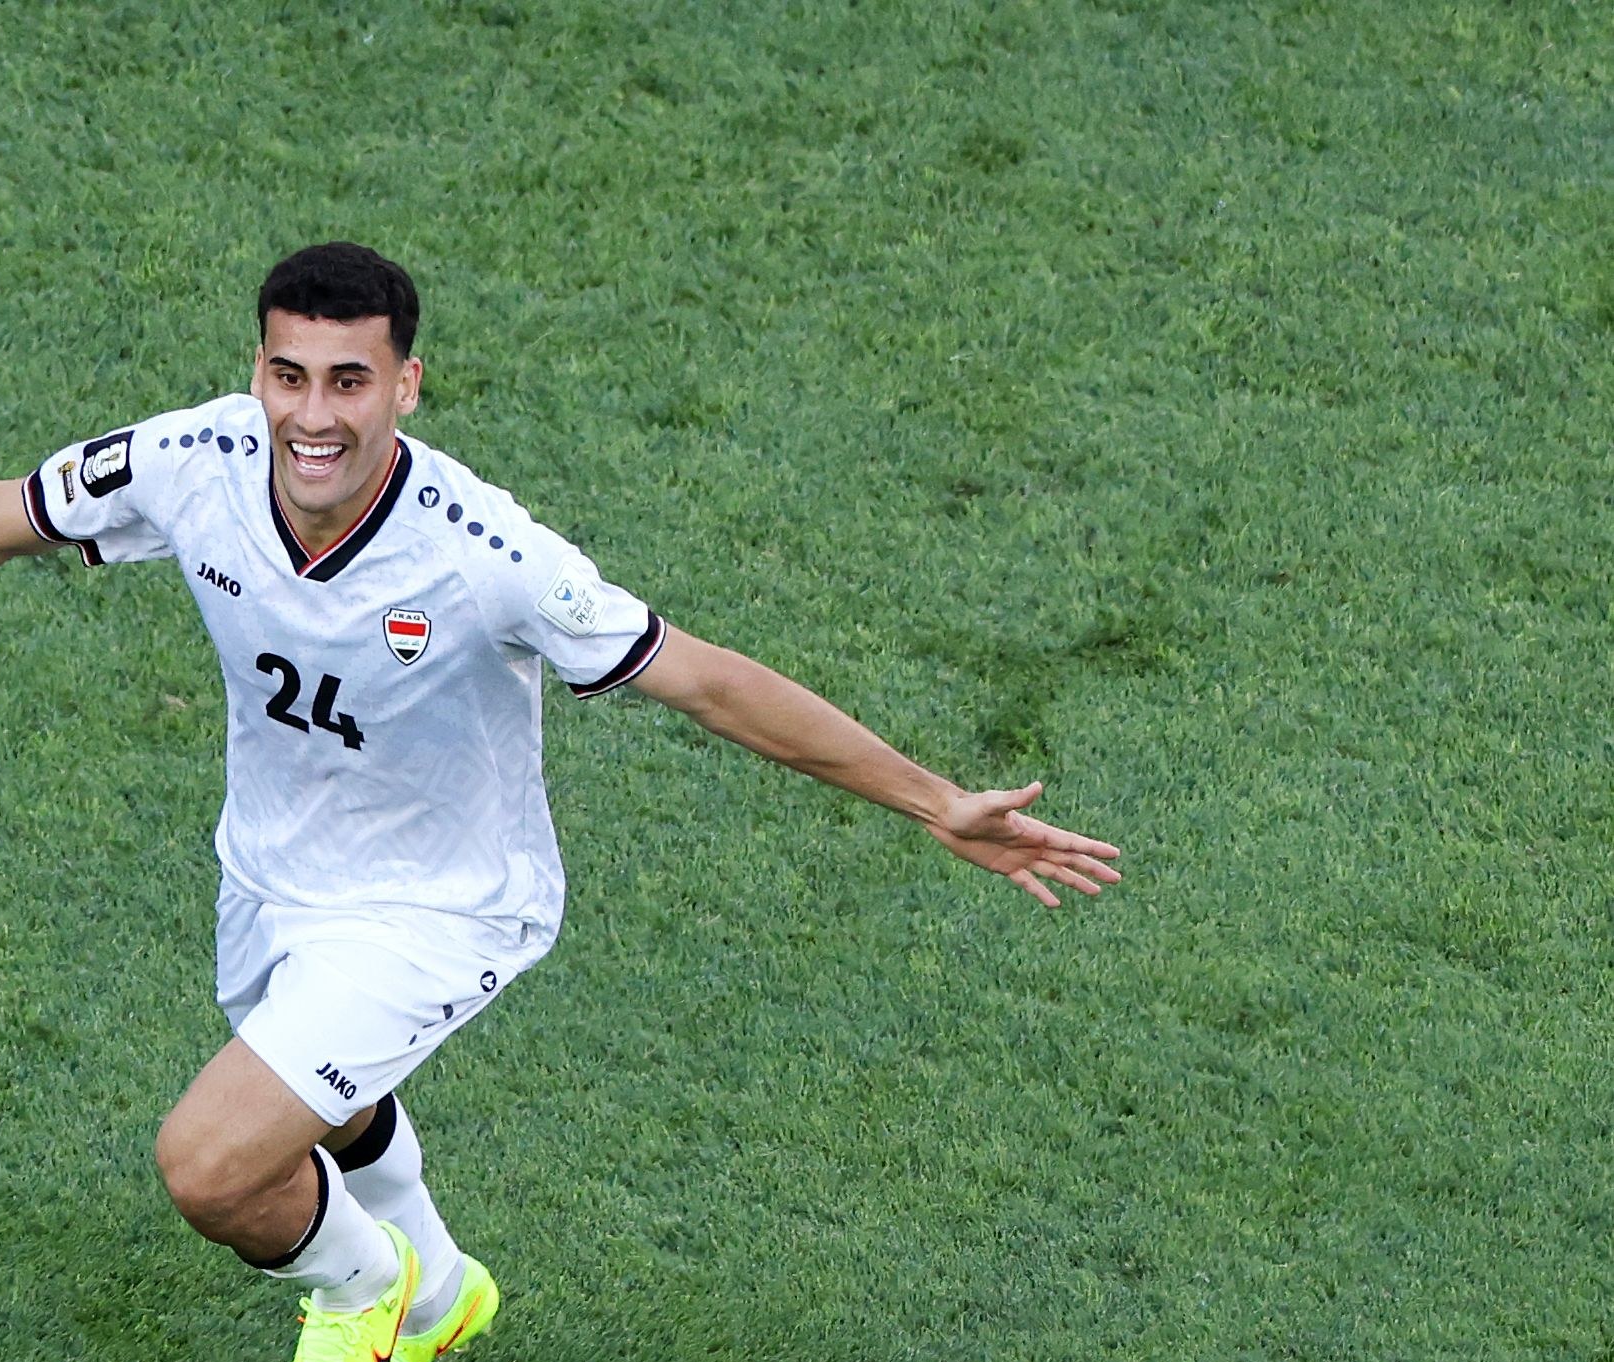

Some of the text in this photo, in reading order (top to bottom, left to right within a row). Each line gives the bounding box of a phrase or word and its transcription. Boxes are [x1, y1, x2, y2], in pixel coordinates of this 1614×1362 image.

[196, 562, 242, 597] JAKO
[393, 612, 421, 621] IRAQ
[255, 652, 366, 752] 24
[315, 1062, 357, 1100] JAKO
